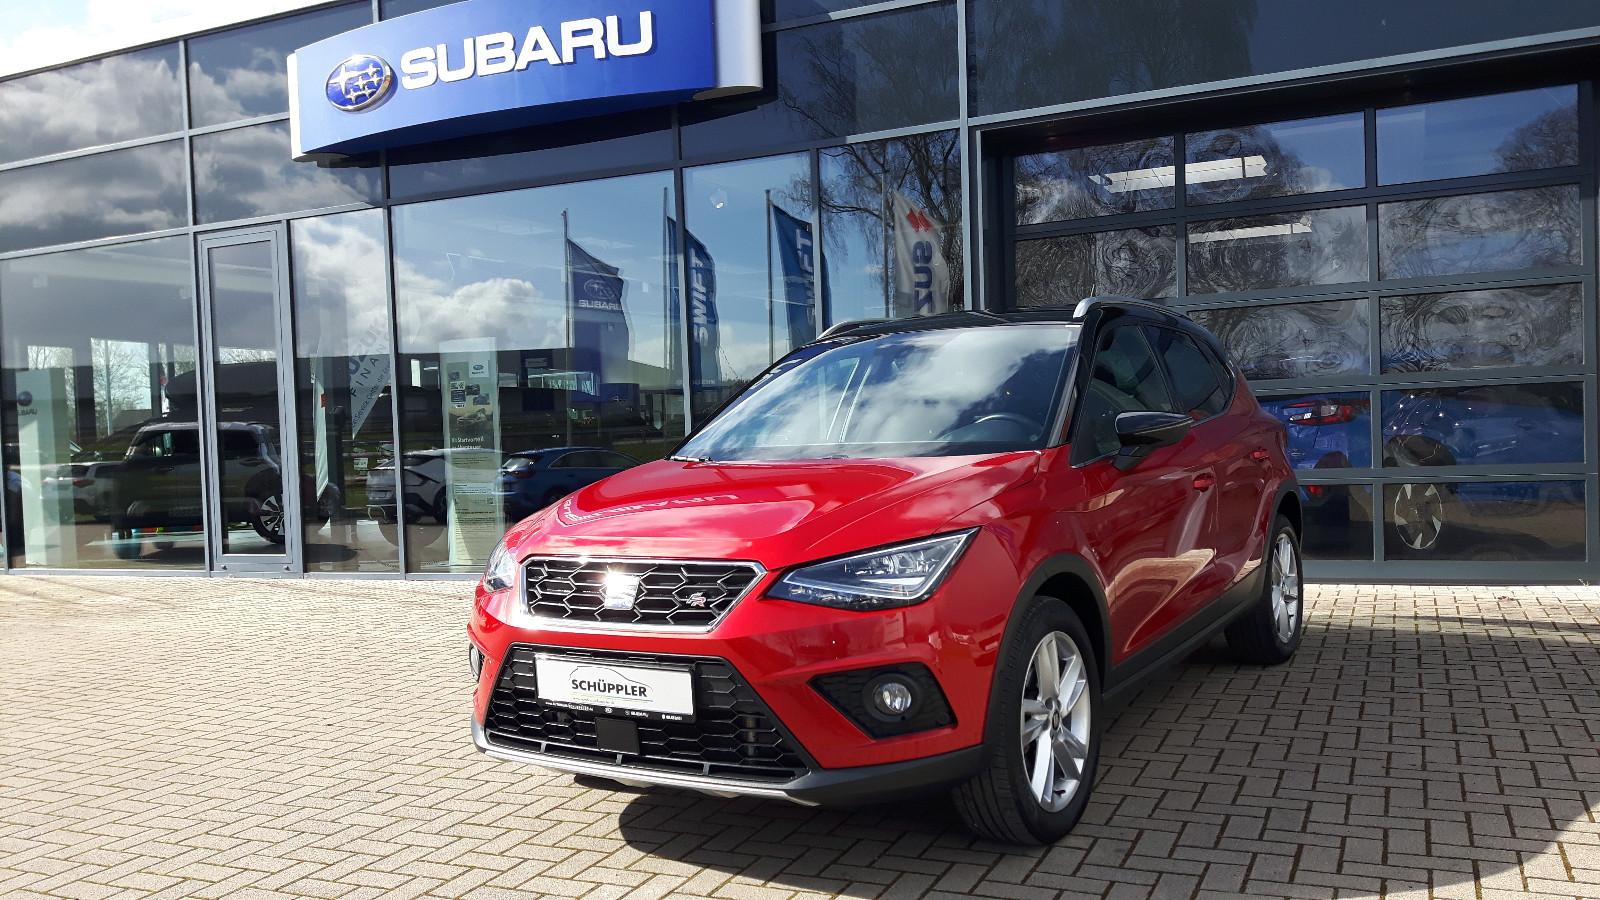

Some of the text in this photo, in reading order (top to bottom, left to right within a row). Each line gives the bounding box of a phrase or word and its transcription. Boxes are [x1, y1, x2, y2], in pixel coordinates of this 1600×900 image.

[400, 10, 653, 90] SUBARU
[690, 247, 709, 346] SWIFT
[571, 679, 647, 697] SCHÜPPLER
